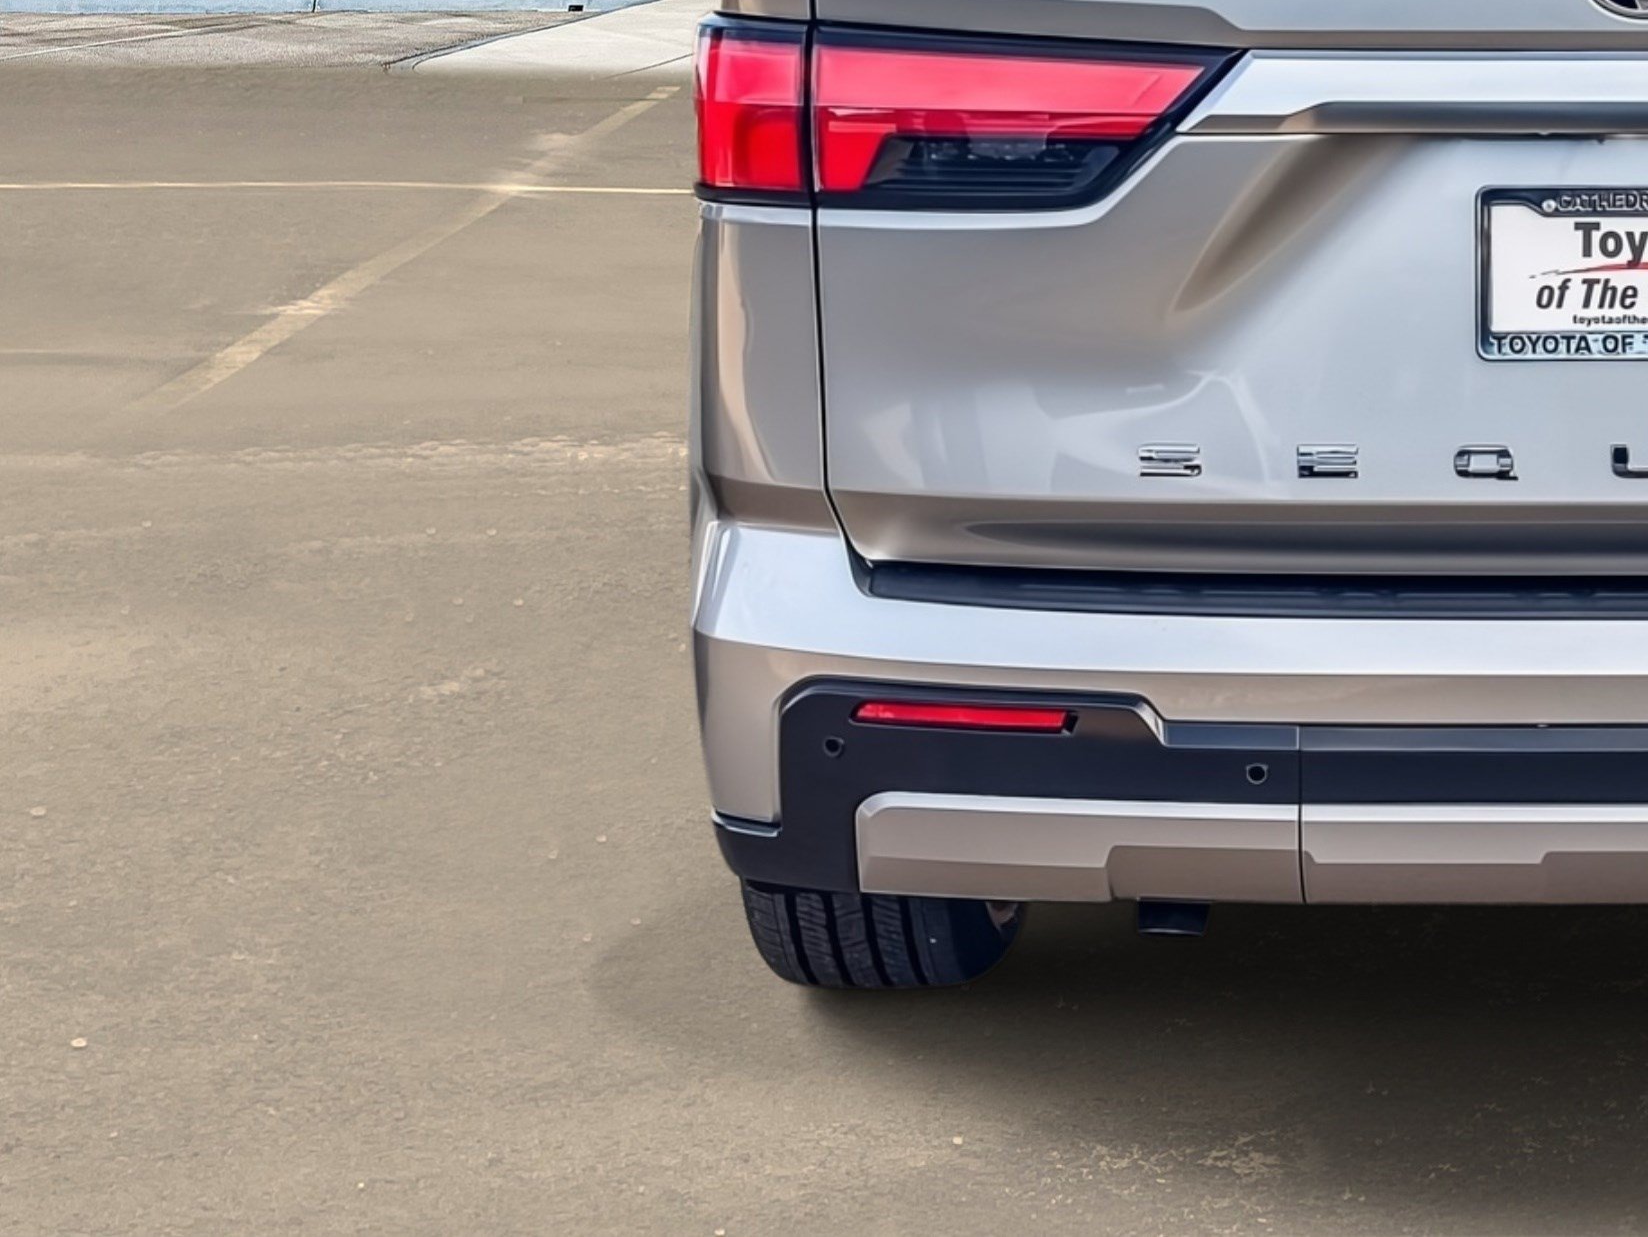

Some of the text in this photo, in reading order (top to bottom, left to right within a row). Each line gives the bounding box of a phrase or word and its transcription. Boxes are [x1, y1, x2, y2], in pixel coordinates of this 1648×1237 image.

[1536, 278, 1571, 309] of
[1581, 278, 1638, 309] The
[1492, 333, 1592, 355] TOYOTA
[1602, 333, 1635, 354] OF
